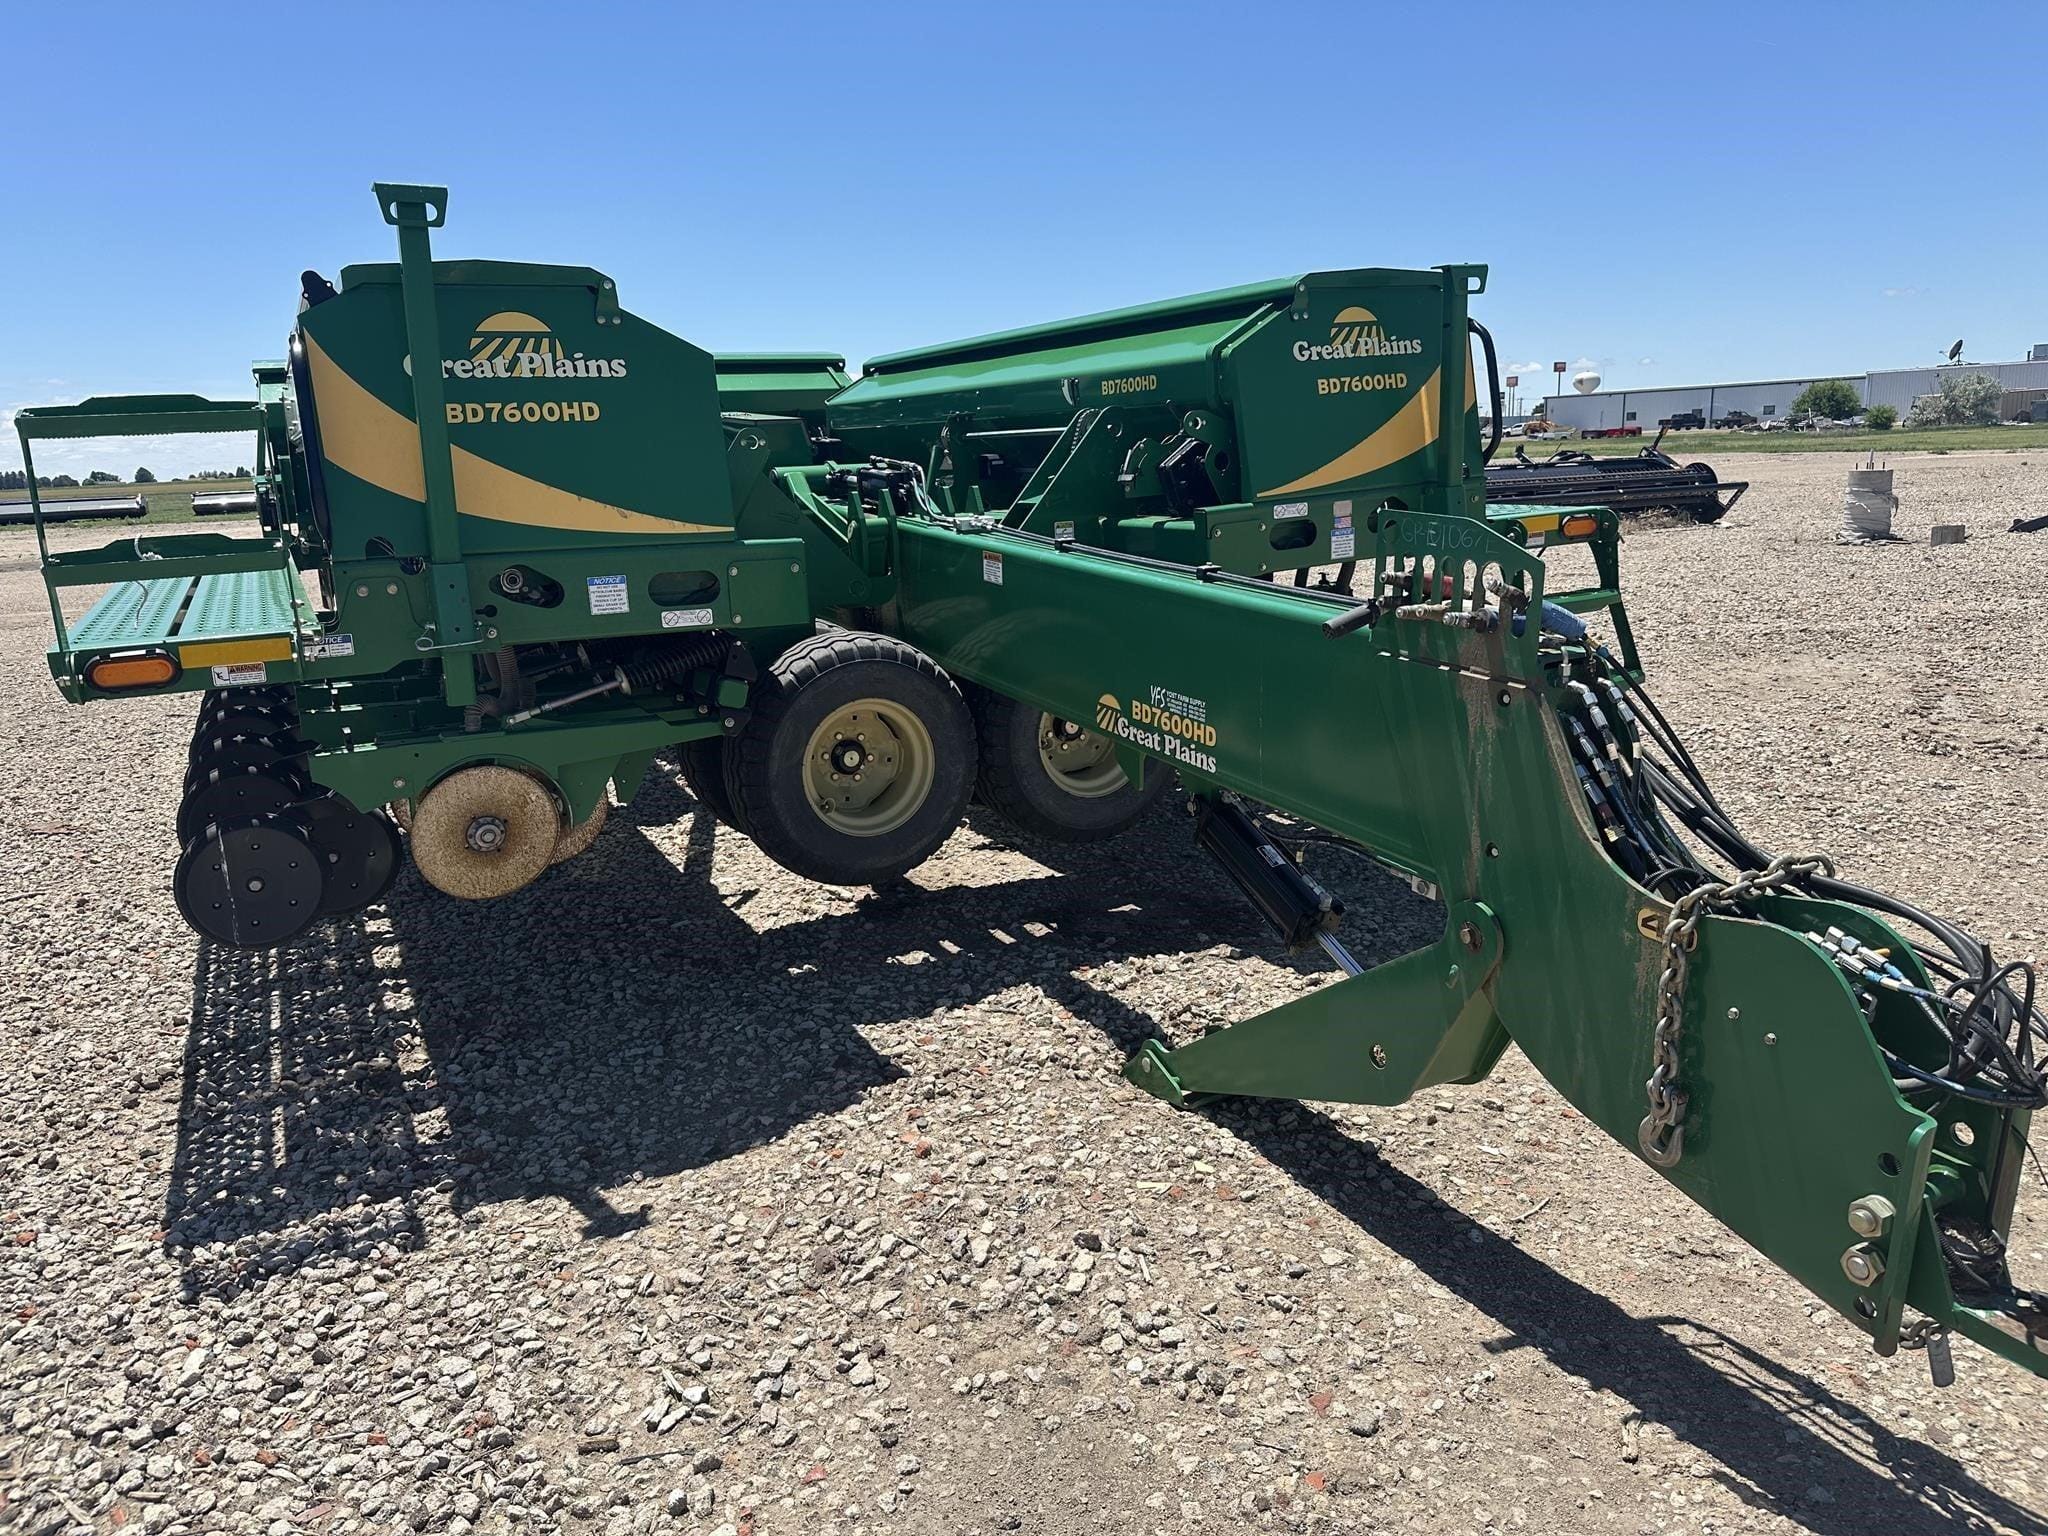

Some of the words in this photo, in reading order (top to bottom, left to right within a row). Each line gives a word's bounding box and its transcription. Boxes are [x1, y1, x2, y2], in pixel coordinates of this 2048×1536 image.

[1293, 341, 1355, 362] Great
[1355, 336, 1422, 358] Plains
[516, 352, 628, 378] Plains
[1101, 375, 1157, 396] BD7600HD
[1317, 373, 1408, 395] BD7600HD
[445, 401, 601, 424] BD7600HD
[1150, 685, 1166, 708] YFS
[1131, 699, 1217, 747] BD7600HD
[1117, 717, 1161, 752] Great
[1163, 734, 1217, 774] Plains
